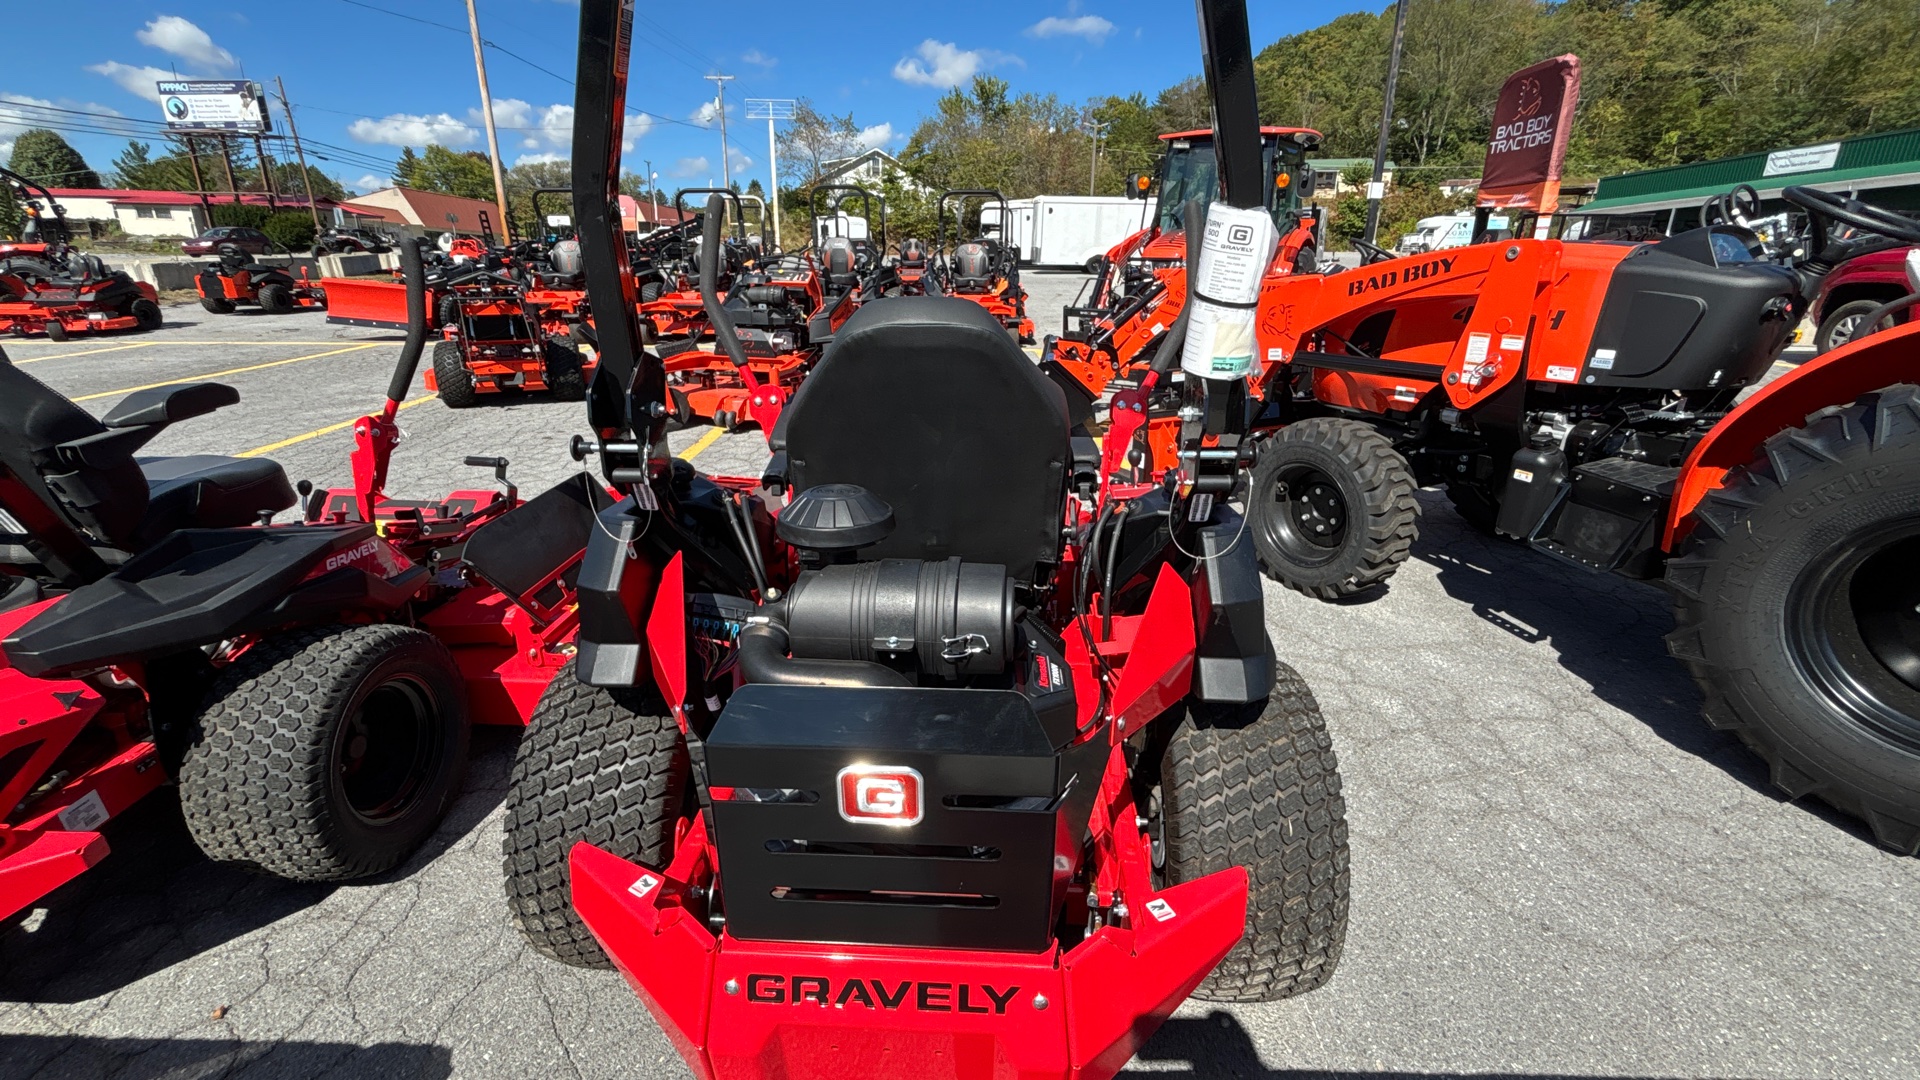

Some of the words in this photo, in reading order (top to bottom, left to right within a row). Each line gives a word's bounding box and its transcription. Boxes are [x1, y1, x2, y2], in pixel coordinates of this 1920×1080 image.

[1490, 129, 1552, 154] TRACTORS
[1496, 122, 1523, 139] BAD
[1526, 114, 1552, 133] BOY
[1220, 244, 1254, 253] GRAVELY
[1348, 271, 1397, 296] BAD
[1403, 255, 1459, 283] BOY
[326, 540, 379, 571] GRAVELY
[856, 777, 905, 815] G
[747, 974, 1022, 1015] GRAVELY
